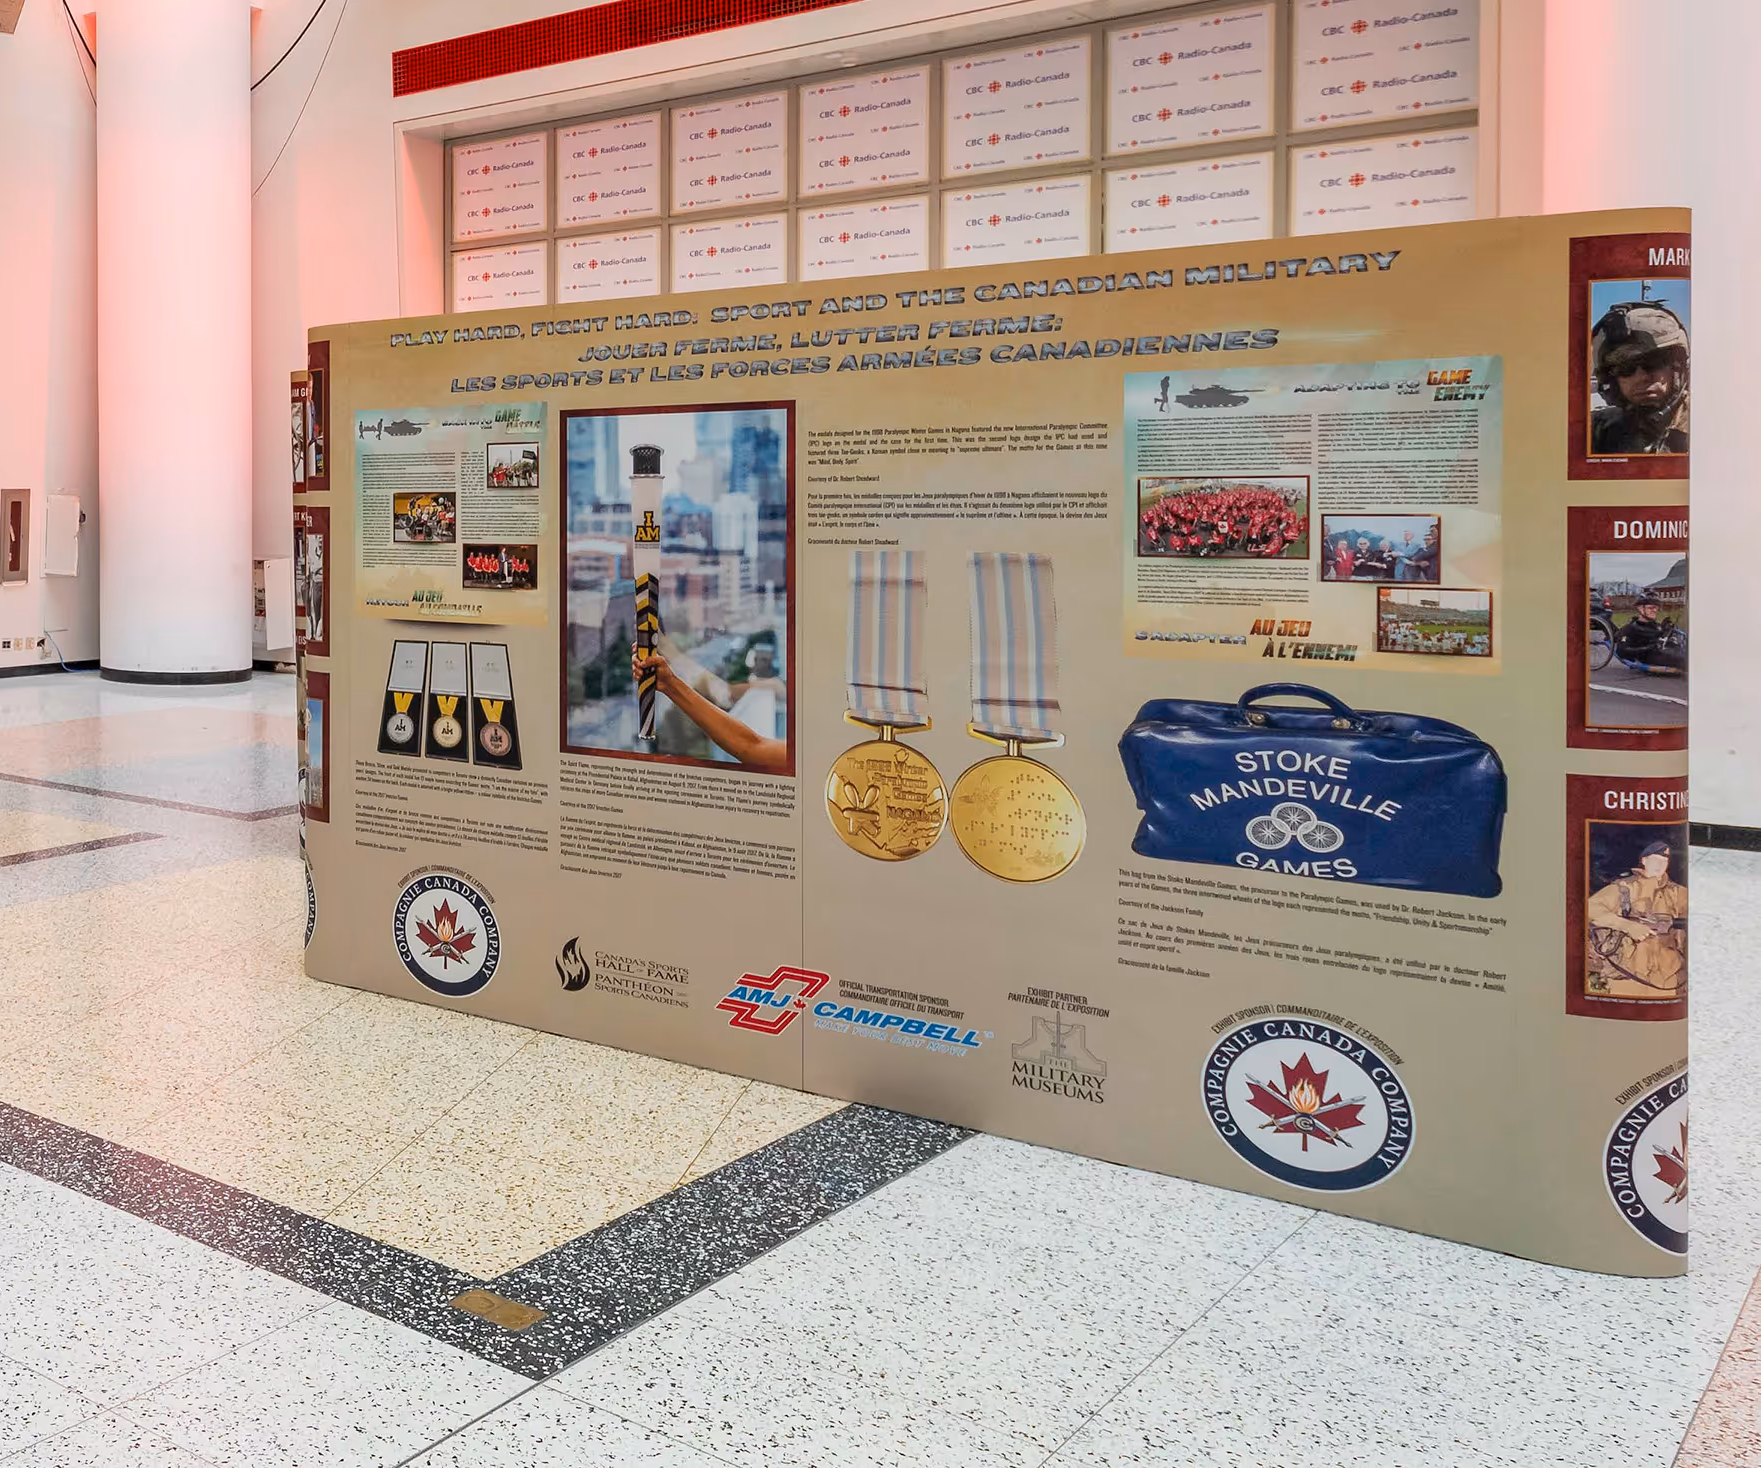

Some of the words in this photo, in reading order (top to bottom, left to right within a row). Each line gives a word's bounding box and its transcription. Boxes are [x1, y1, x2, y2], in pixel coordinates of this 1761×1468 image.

[1322, 25, 1345, 37] CBC
[1373, 7, 1458, 29] Radio-Canada
[1132, 55, 1152, 67] CBC
[1176, 41, 1252, 61] Radio-Canada
[818, 108, 836, 120] CBC
[853, 97, 912, 114] Radio-Canada
[572, 149, 586, 160] CBC
[600, 141, 647, 155] Radio-Canada
[1648, 247, 1691, 266] MARK
[391, 330, 448, 347] PLAY
[453, 324, 526, 342] HARD,
[531, 317, 609, 337] FIGHT
[615, 309, 698, 329] HARD:
[710, 300, 812, 323] SPORT
[819, 293, 888, 315] AND
[896, 287, 966, 308] THE
[973, 269, 1173, 302] CANADIAN
[1185, 250, 1401, 286] MILITARY
[578, 342, 667, 363] JOUER
[674, 333, 783, 357] FERME,
[790, 323, 922, 348] LUTTER
[927, 313, 1064, 338] FERME:
[450, 376, 496, 393] LES
[500, 369, 604, 390] SPORTS
[609, 367, 645, 384] ET
[650, 363, 704, 382] LES
[710, 356, 831, 379] FORCES
[837, 345, 982, 372] ARMÉES
[990, 328, 1279, 364] CANADIENNES
[1293, 380, 1390, 394] ADAPTING
[1426, 369, 1472, 386] GAME
[1433, 384, 1490, 401] ENEMY
[644, 511, 653, 527] I
[1614, 520, 1688, 539] DOMINIC
[635, 525, 660, 542] AM
[1249, 618, 1277, 636] AU
[1277, 620, 1312, 638] JEU
[1262, 641, 1274, 658] À
[1277, 643, 1358, 662] L'ENNEMI
[1234, 750, 1352, 780] STOKE
[1189, 777, 1402, 822] MANDEVILLE
[1235, 852, 1358, 878] GAMES
[396, 883, 422, 961] COMPAGNIE
[424, 878, 477, 904] CANADA
[479, 905, 498, 978] COMPANY
[595, 959, 634, 973] HALL
[647, 969, 689, 985] FAME
[595, 973, 674, 997] PANTHÉON
[838, 980, 864, 992] OFFICIAL
[865, 984, 918, 1002] TRANSPORTATION
[919, 993, 949, 1007] SPONSOR
[838, 989, 889, 1007] COMMANDITAIRE
[889, 998, 916, 1012] OFFICIEL
[916, 1003, 926, 1013] DU
[927, 1005, 964, 1020] TRANSPORT
[728, 986, 792, 1008] AMJ
[813, 1001, 982, 1047] CAMPBELL
[1012, 1061, 1105, 1090] MILITARY
[1012, 1074, 1105, 1104] MUSEUMS
[1207, 1028, 1258, 1137] COMPAGNIE
[1263, 1022, 1366, 1064] CANADA
[1371, 1067, 1409, 1169] COMPANY
[1610, 1094, 1665, 1219] COMPAGNIE
